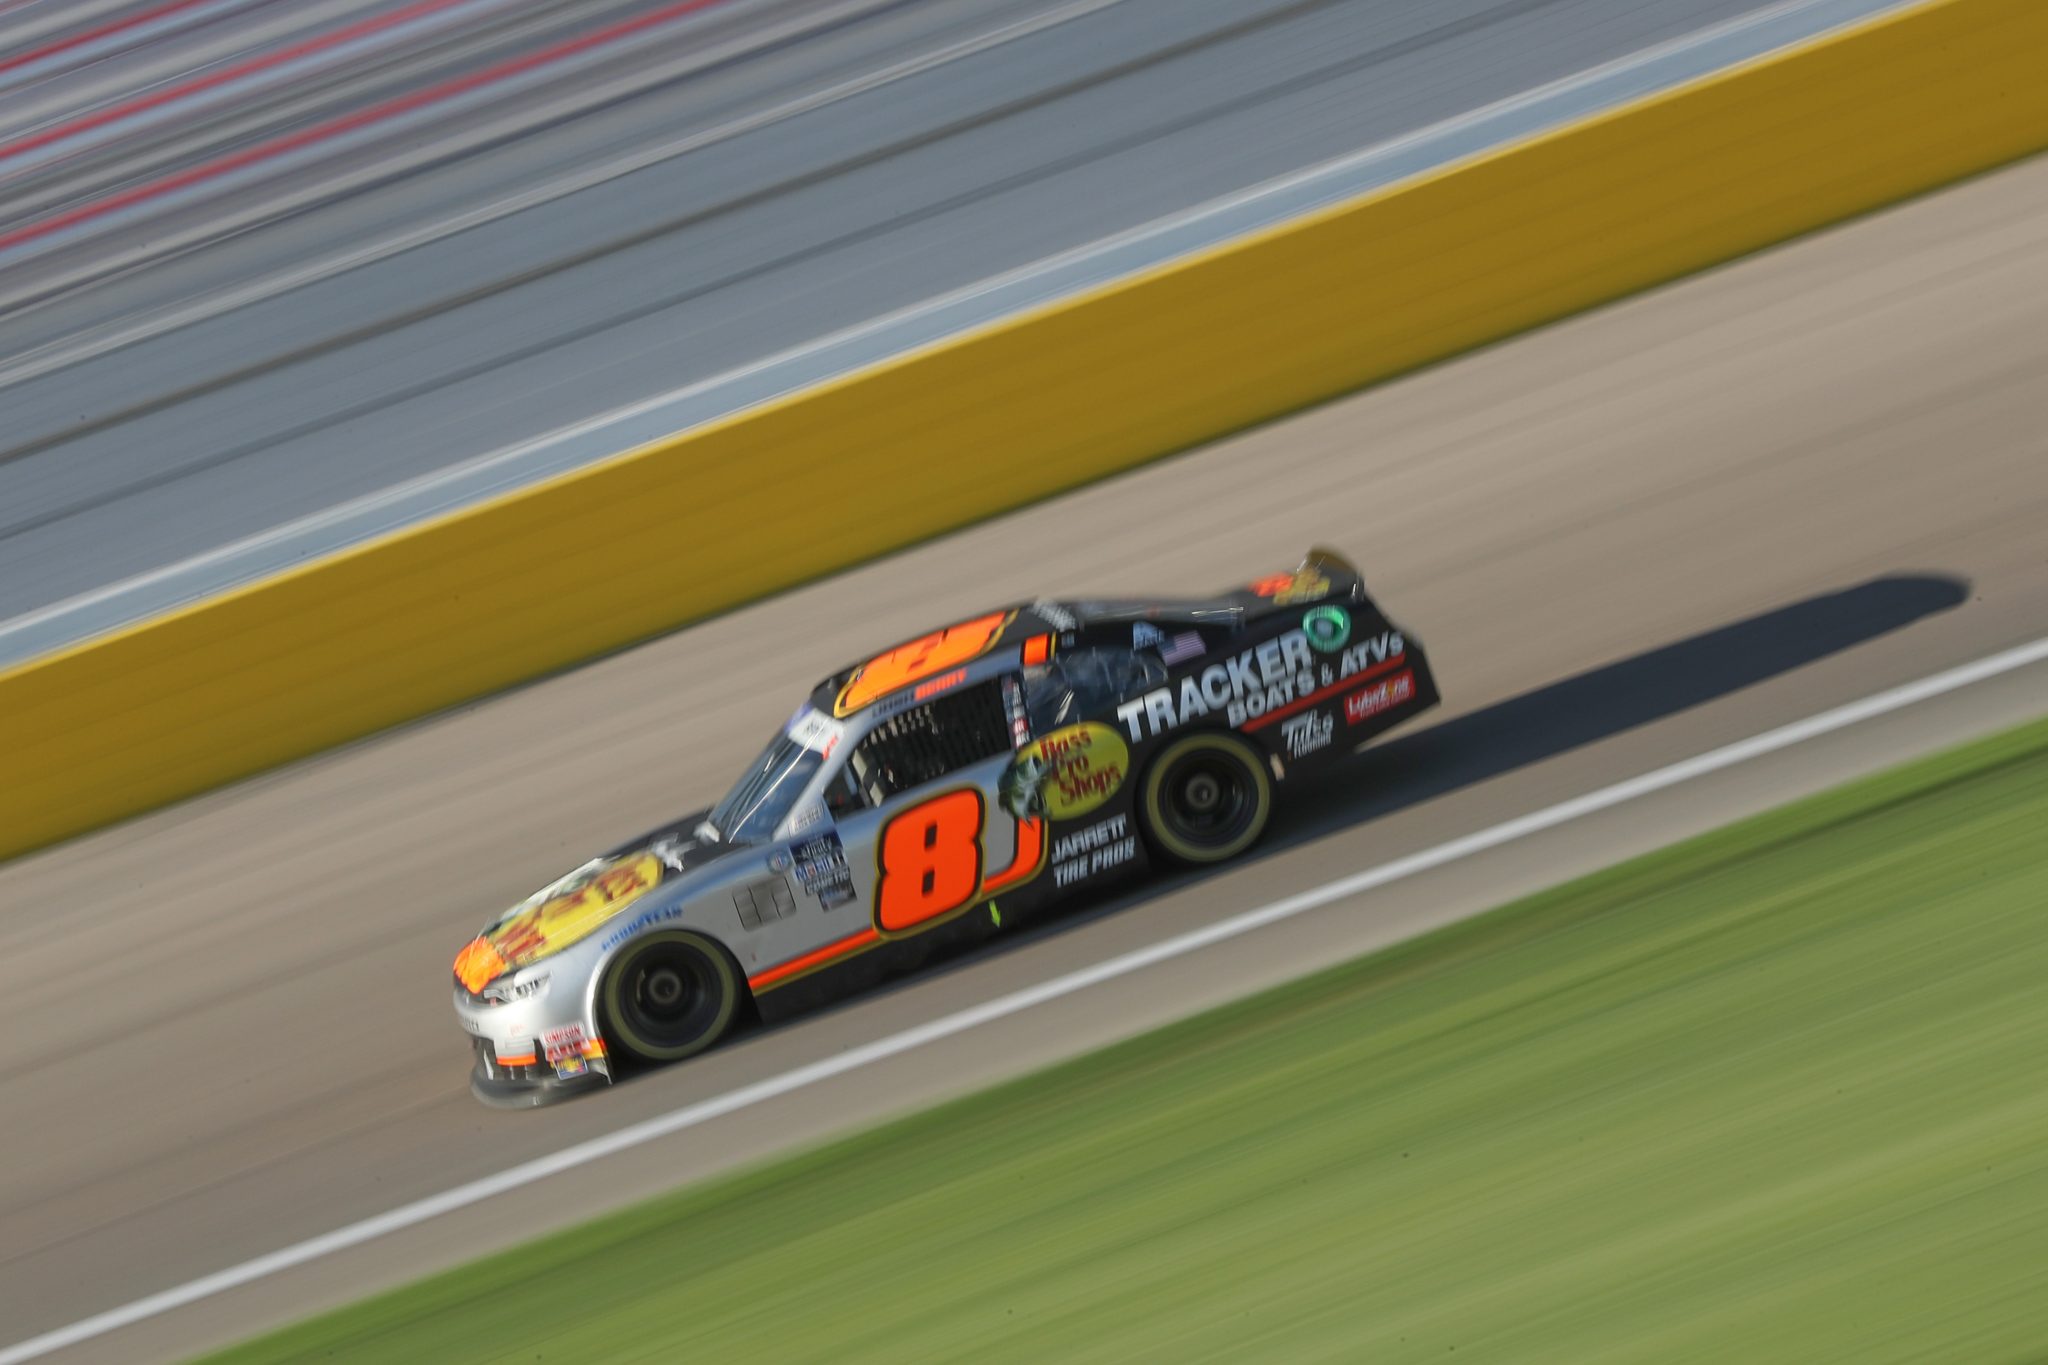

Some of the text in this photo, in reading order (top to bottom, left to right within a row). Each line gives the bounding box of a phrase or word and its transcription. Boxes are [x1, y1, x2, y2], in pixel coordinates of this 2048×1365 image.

[1117, 628, 1313, 743] TRACKER
[1226, 670, 1315, 728] BOATS
[1320, 662, 1334, 687] &
[1340, 631, 1404, 681] ATVs
[1039, 727, 1092, 763] Bass
[1048, 753, 1090, 784] Pro
[1058, 762, 1122, 807] Shops
[876, 786, 982, 936] 8
[1051, 813, 1127, 865] JARRETT
[1053, 857, 1089, 888] TIRE
